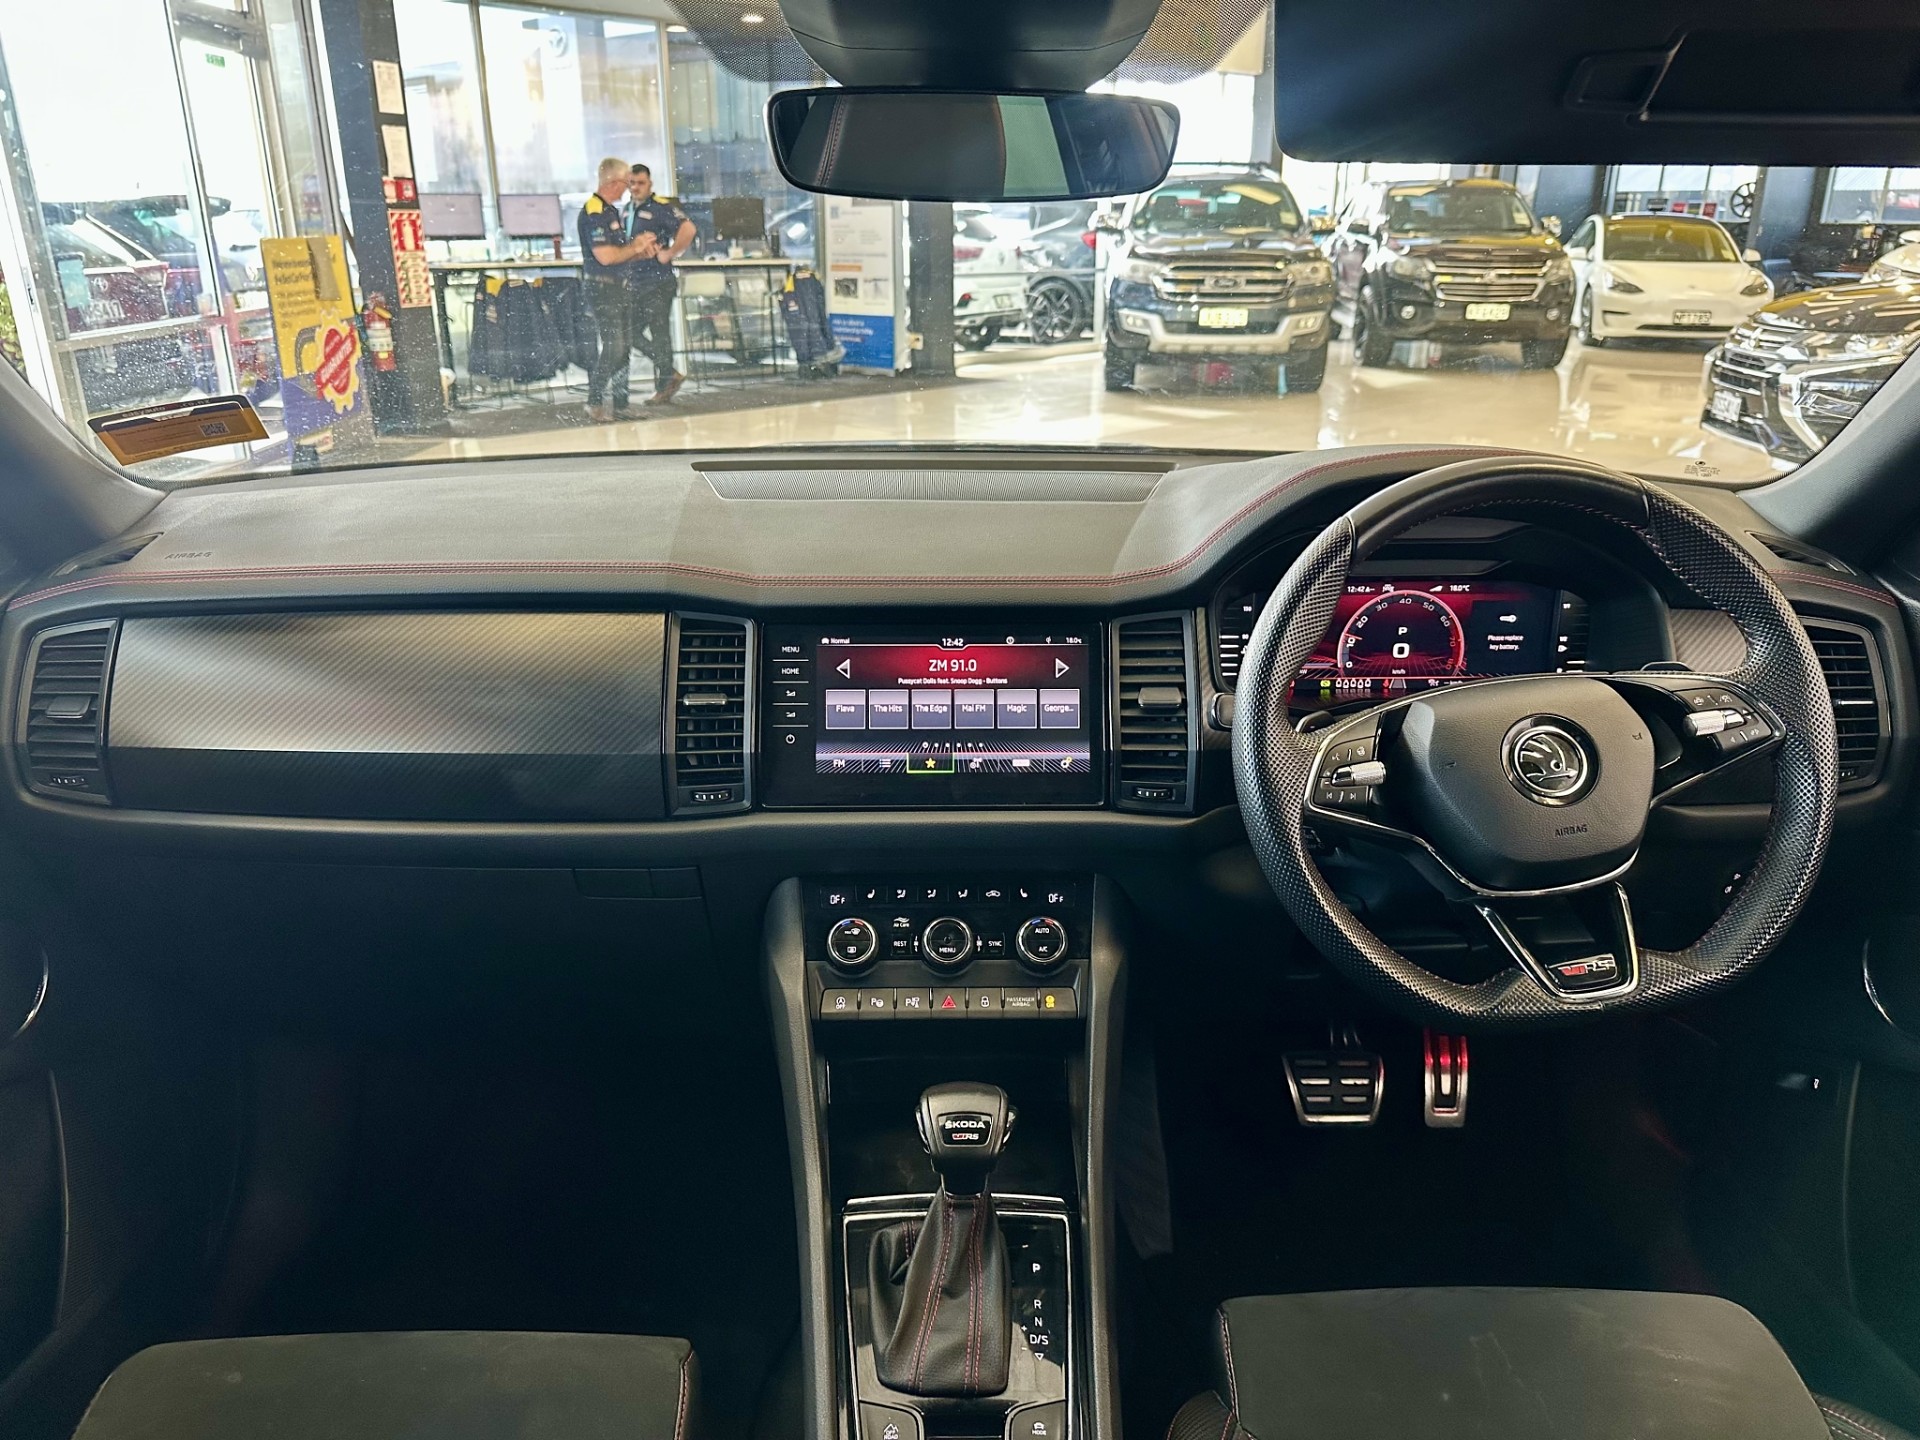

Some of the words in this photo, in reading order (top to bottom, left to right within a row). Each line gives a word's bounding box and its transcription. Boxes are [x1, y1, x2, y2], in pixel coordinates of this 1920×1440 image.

[164, 551, 212, 559] AIRBAG
[1375, 602, 1388, 611] 30
[1422, 602, 1435, 611] 50
[1355, 615, 1369, 628] 20
[1440, 615, 1451, 627] 60
[1398, 627, 1408, 635] P
[942, 638, 963, 646] 12:42
[1346, 637, 1356, 648] 10
[1392, 643, 1410, 659] 0
[929, 660, 948, 671] ZM
[950, 660, 977, 672] 91.0
[931, 705, 947, 713] Edge
[1007, 705, 1027, 713] Magic
[833, 758, 845, 767] FM
[1554, 824, 1588, 837] AIRBAG
[1032, 1263, 1041, 1273] P
[1034, 1299, 1042, 1310] R
[1034, 1316, 1043, 1327] N
[1029, 1334, 1049, 1345] D/S
